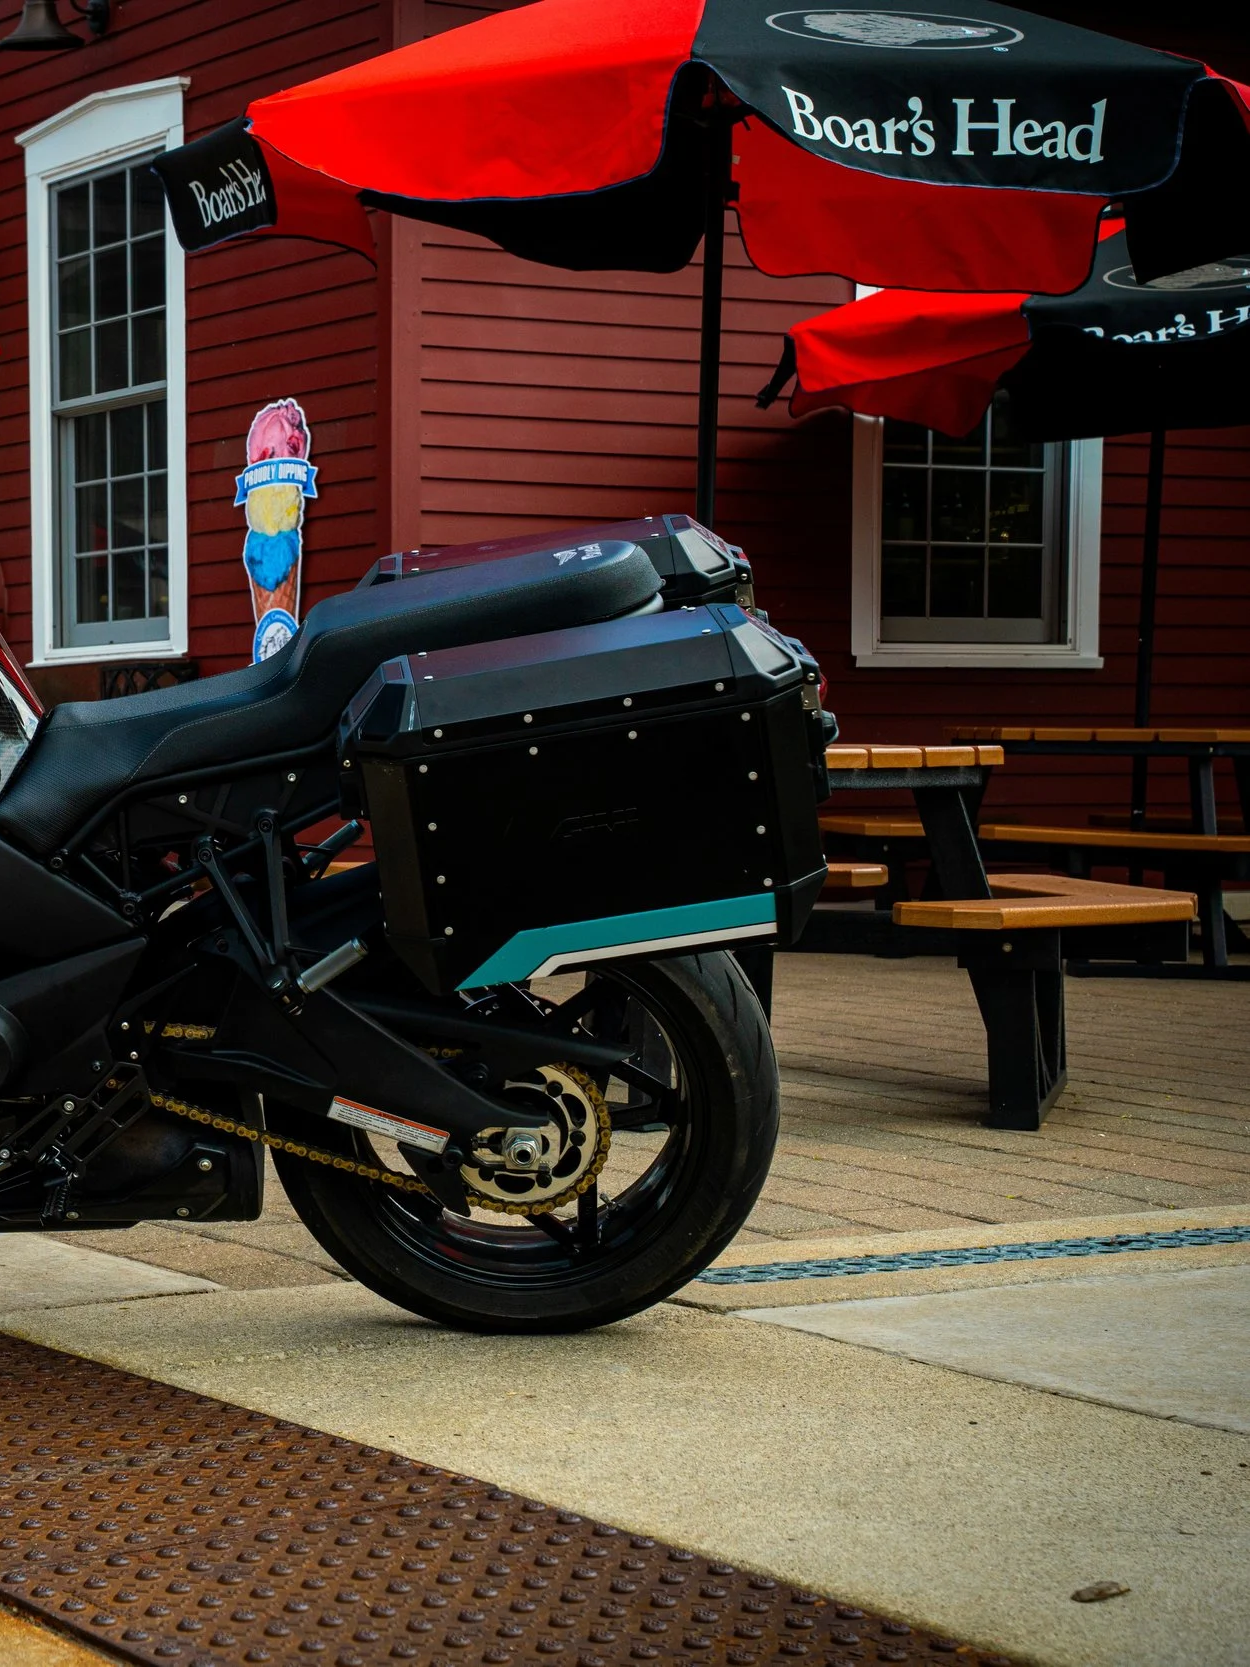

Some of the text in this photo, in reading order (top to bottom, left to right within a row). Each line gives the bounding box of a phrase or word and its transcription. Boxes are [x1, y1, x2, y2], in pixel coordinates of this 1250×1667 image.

[782, 86, 1107, 164] Boar's Head
[189, 167, 246, 228] Boar's
[244, 463, 308, 489] PROUDLY DIPPING
